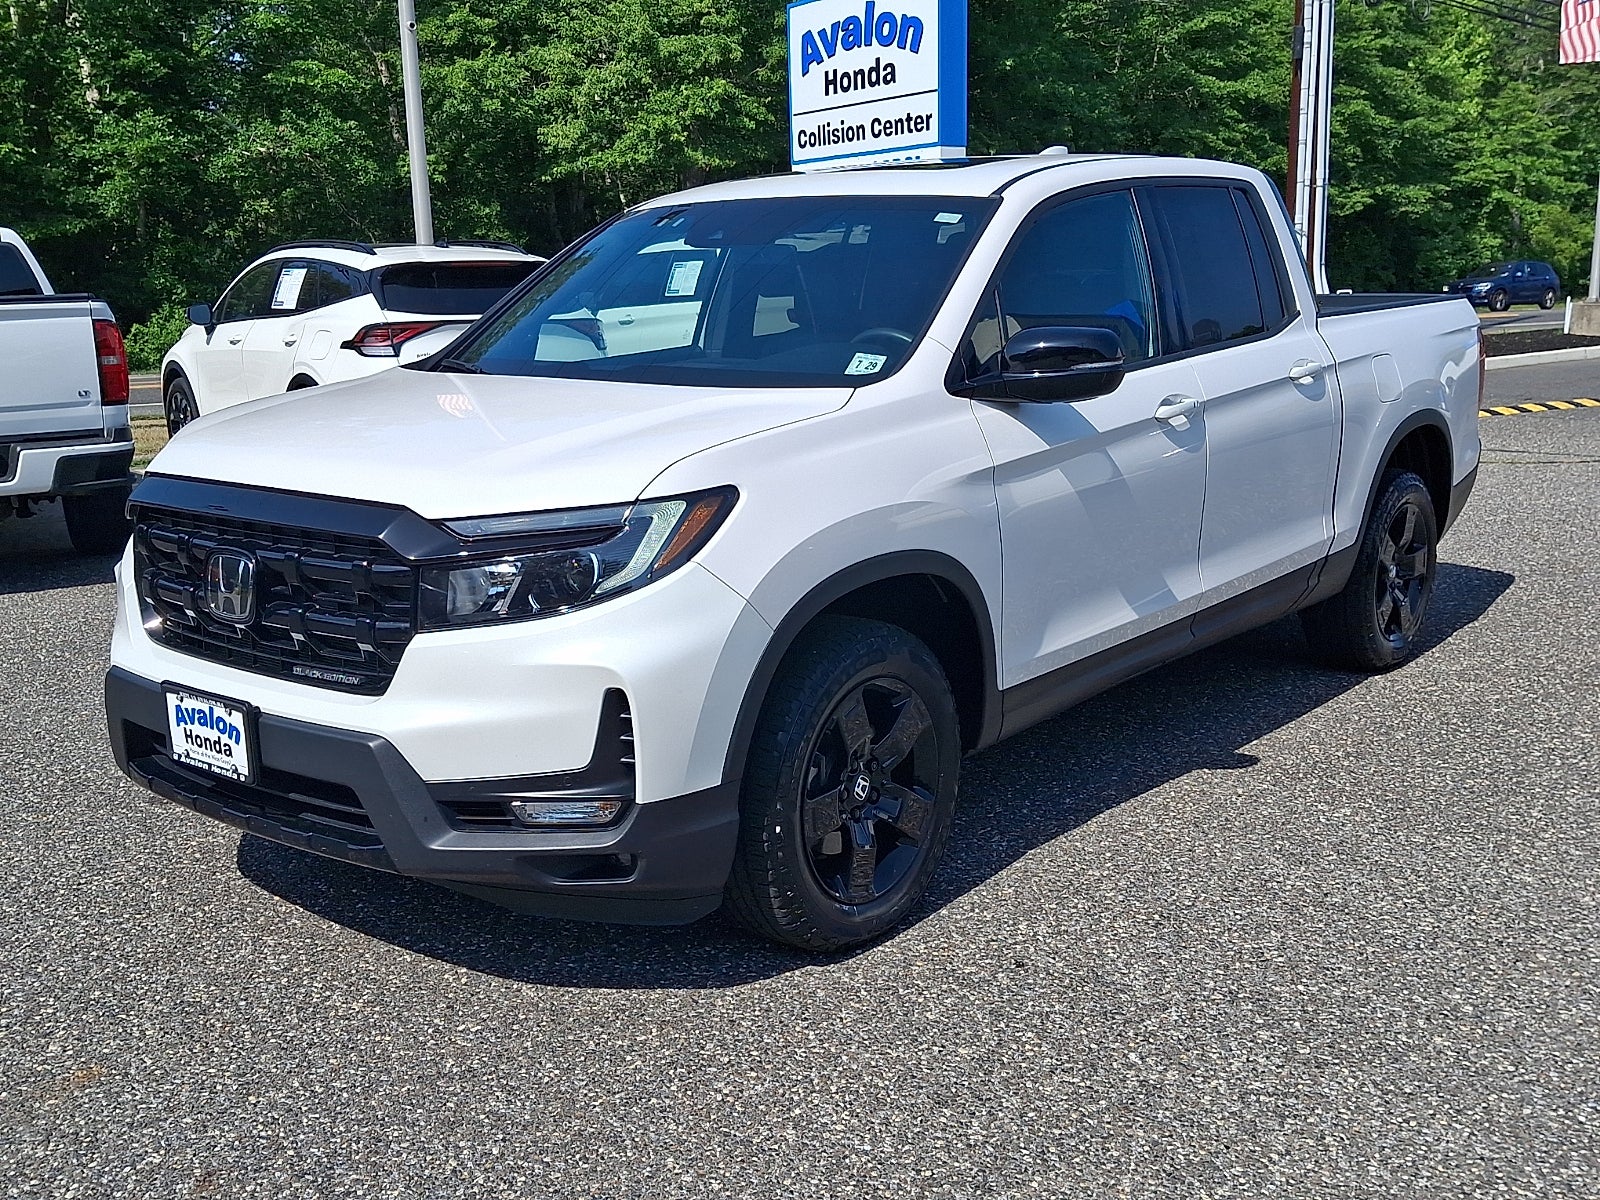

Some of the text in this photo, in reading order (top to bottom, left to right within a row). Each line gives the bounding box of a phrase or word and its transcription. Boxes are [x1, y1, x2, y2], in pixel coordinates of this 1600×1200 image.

[802, 1, 924, 77] Avalon
[824, 57, 896, 96] Honda
[797, 112, 933, 149] Collision Center
[855, 360, 878, 370] 7 29
[323, 673, 360, 685] EDITION
[175, 704, 241, 746] Avalon
[183, 727, 233, 759] Honda
[180, 755, 209, 770] Avalon
[211, 764, 238, 780] Honda
